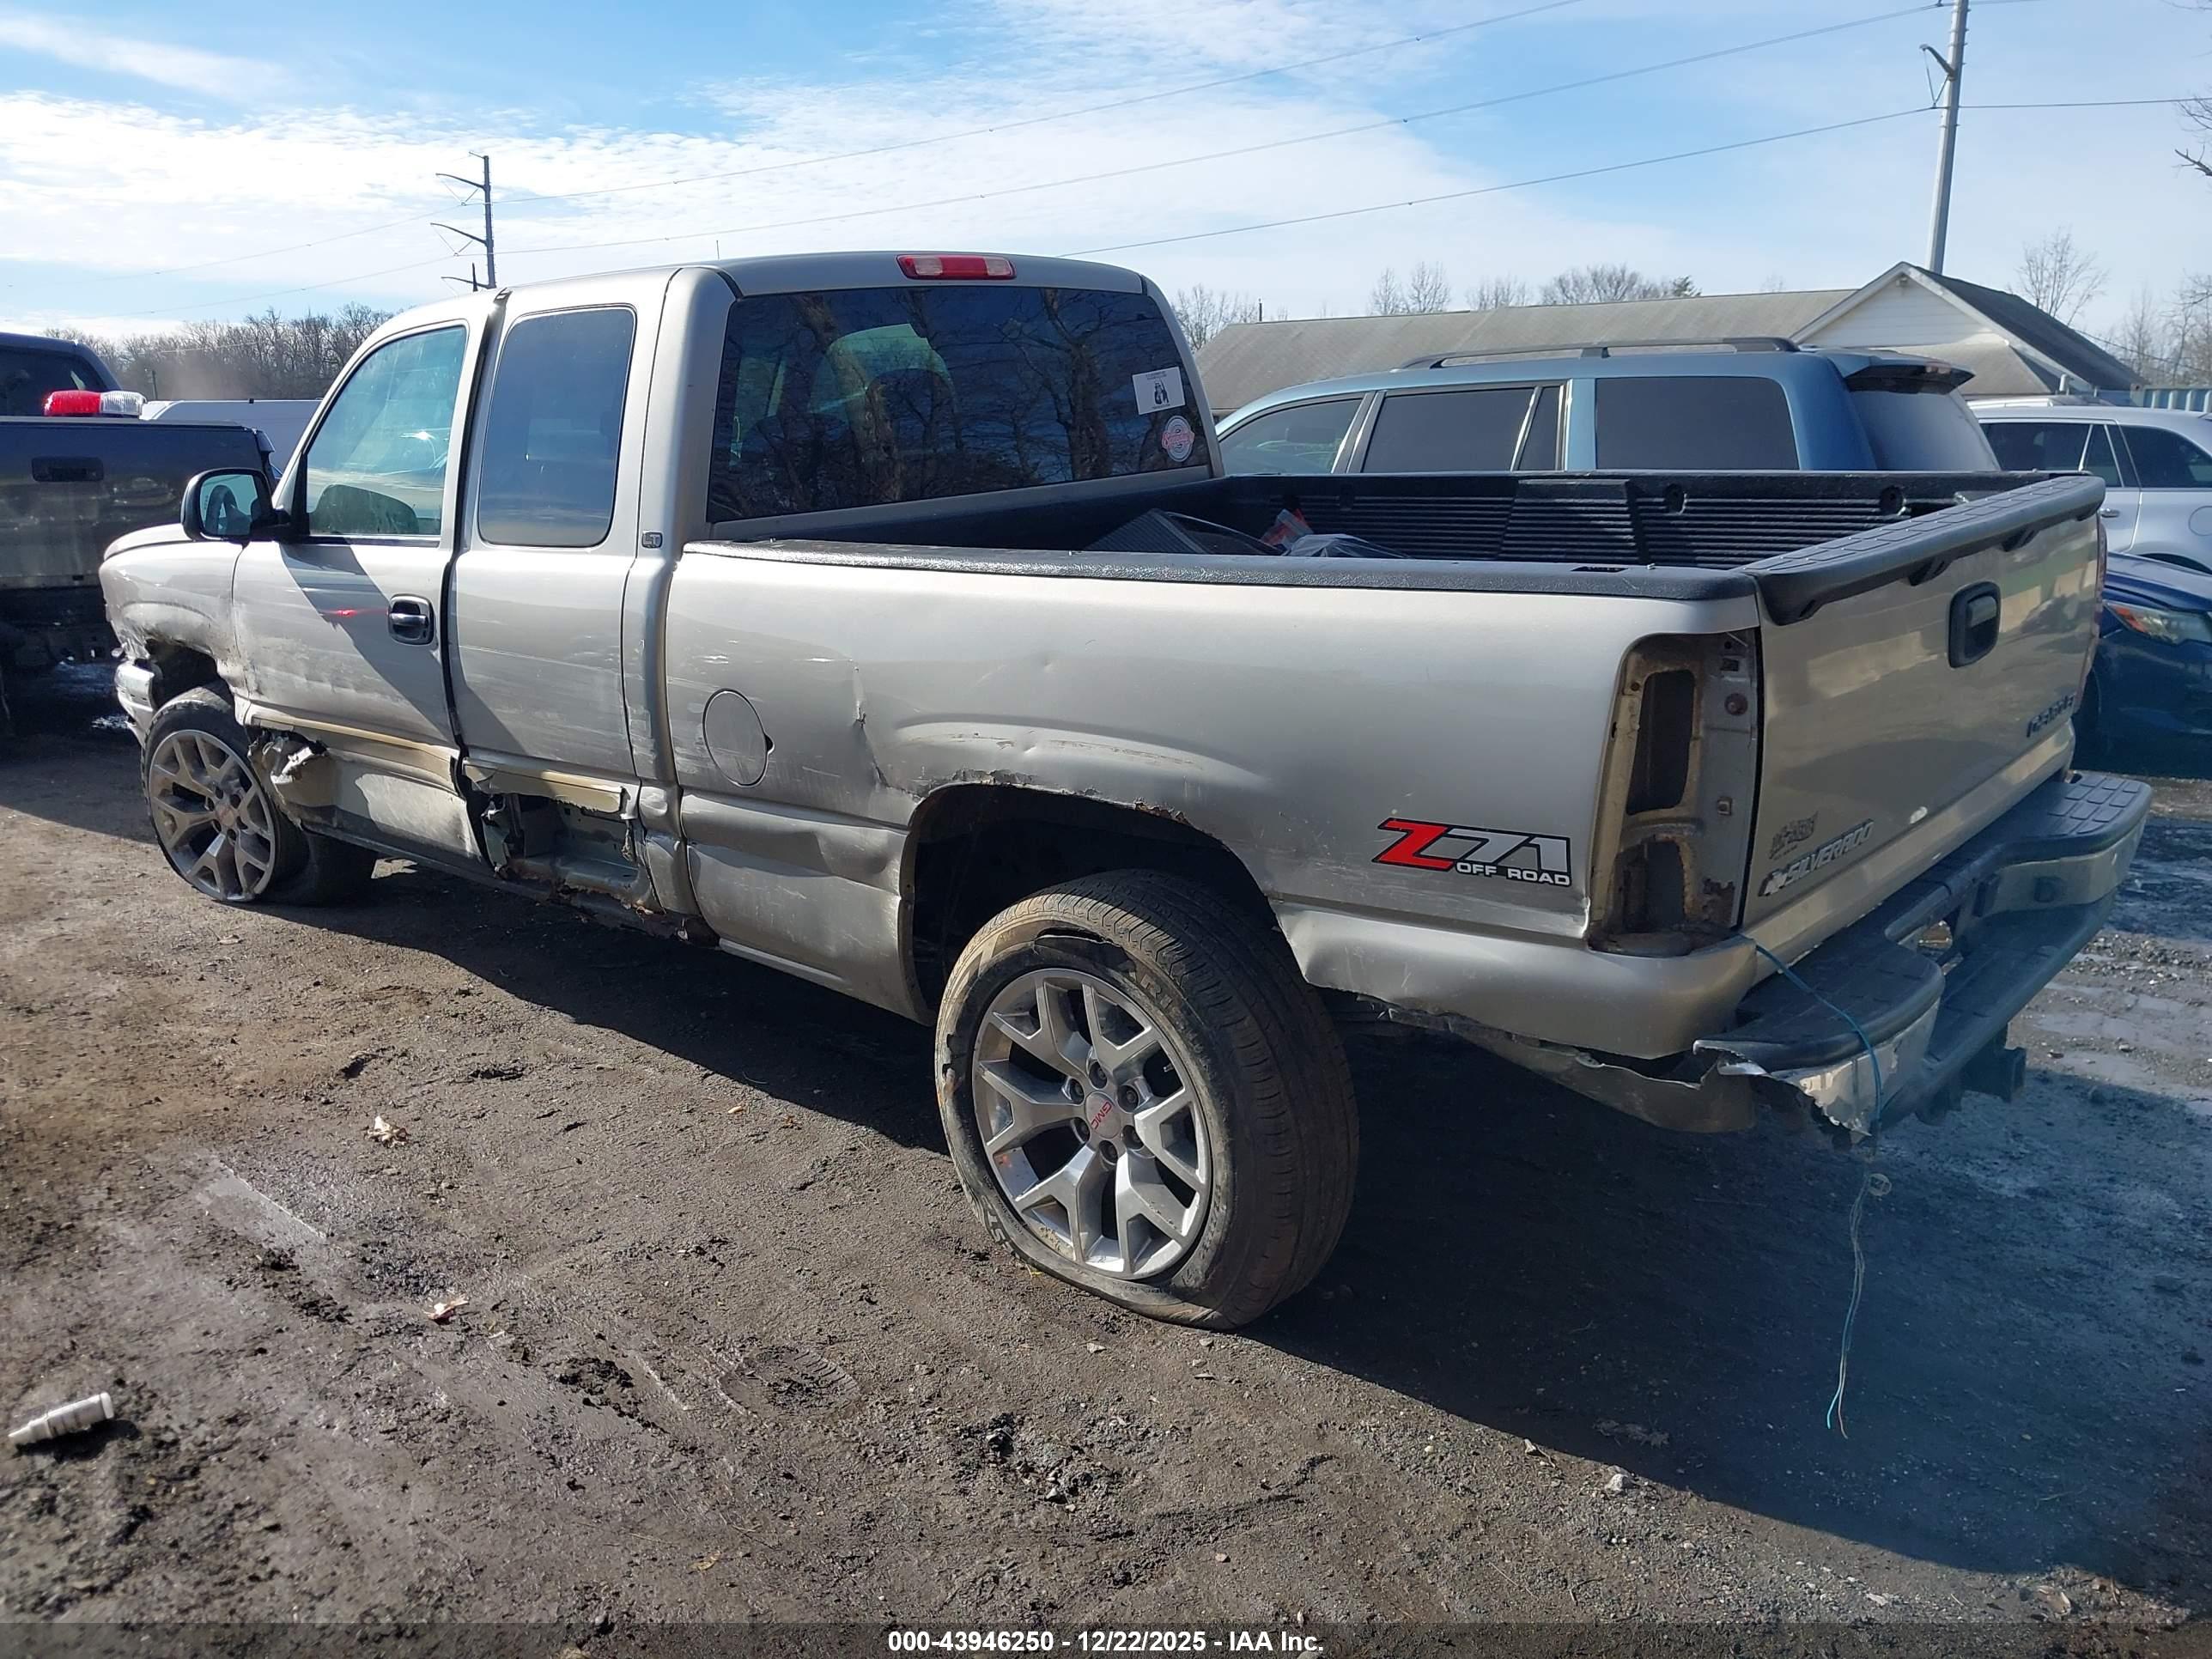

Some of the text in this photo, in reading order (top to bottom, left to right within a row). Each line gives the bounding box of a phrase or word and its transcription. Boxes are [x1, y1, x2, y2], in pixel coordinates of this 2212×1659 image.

[1371, 817, 1571, 872] Z71
[1785, 818, 1875, 885] SILVERADO
[1455, 861, 1571, 886] OFF ROAD
[1091, 1100, 1113, 1130] GMC
